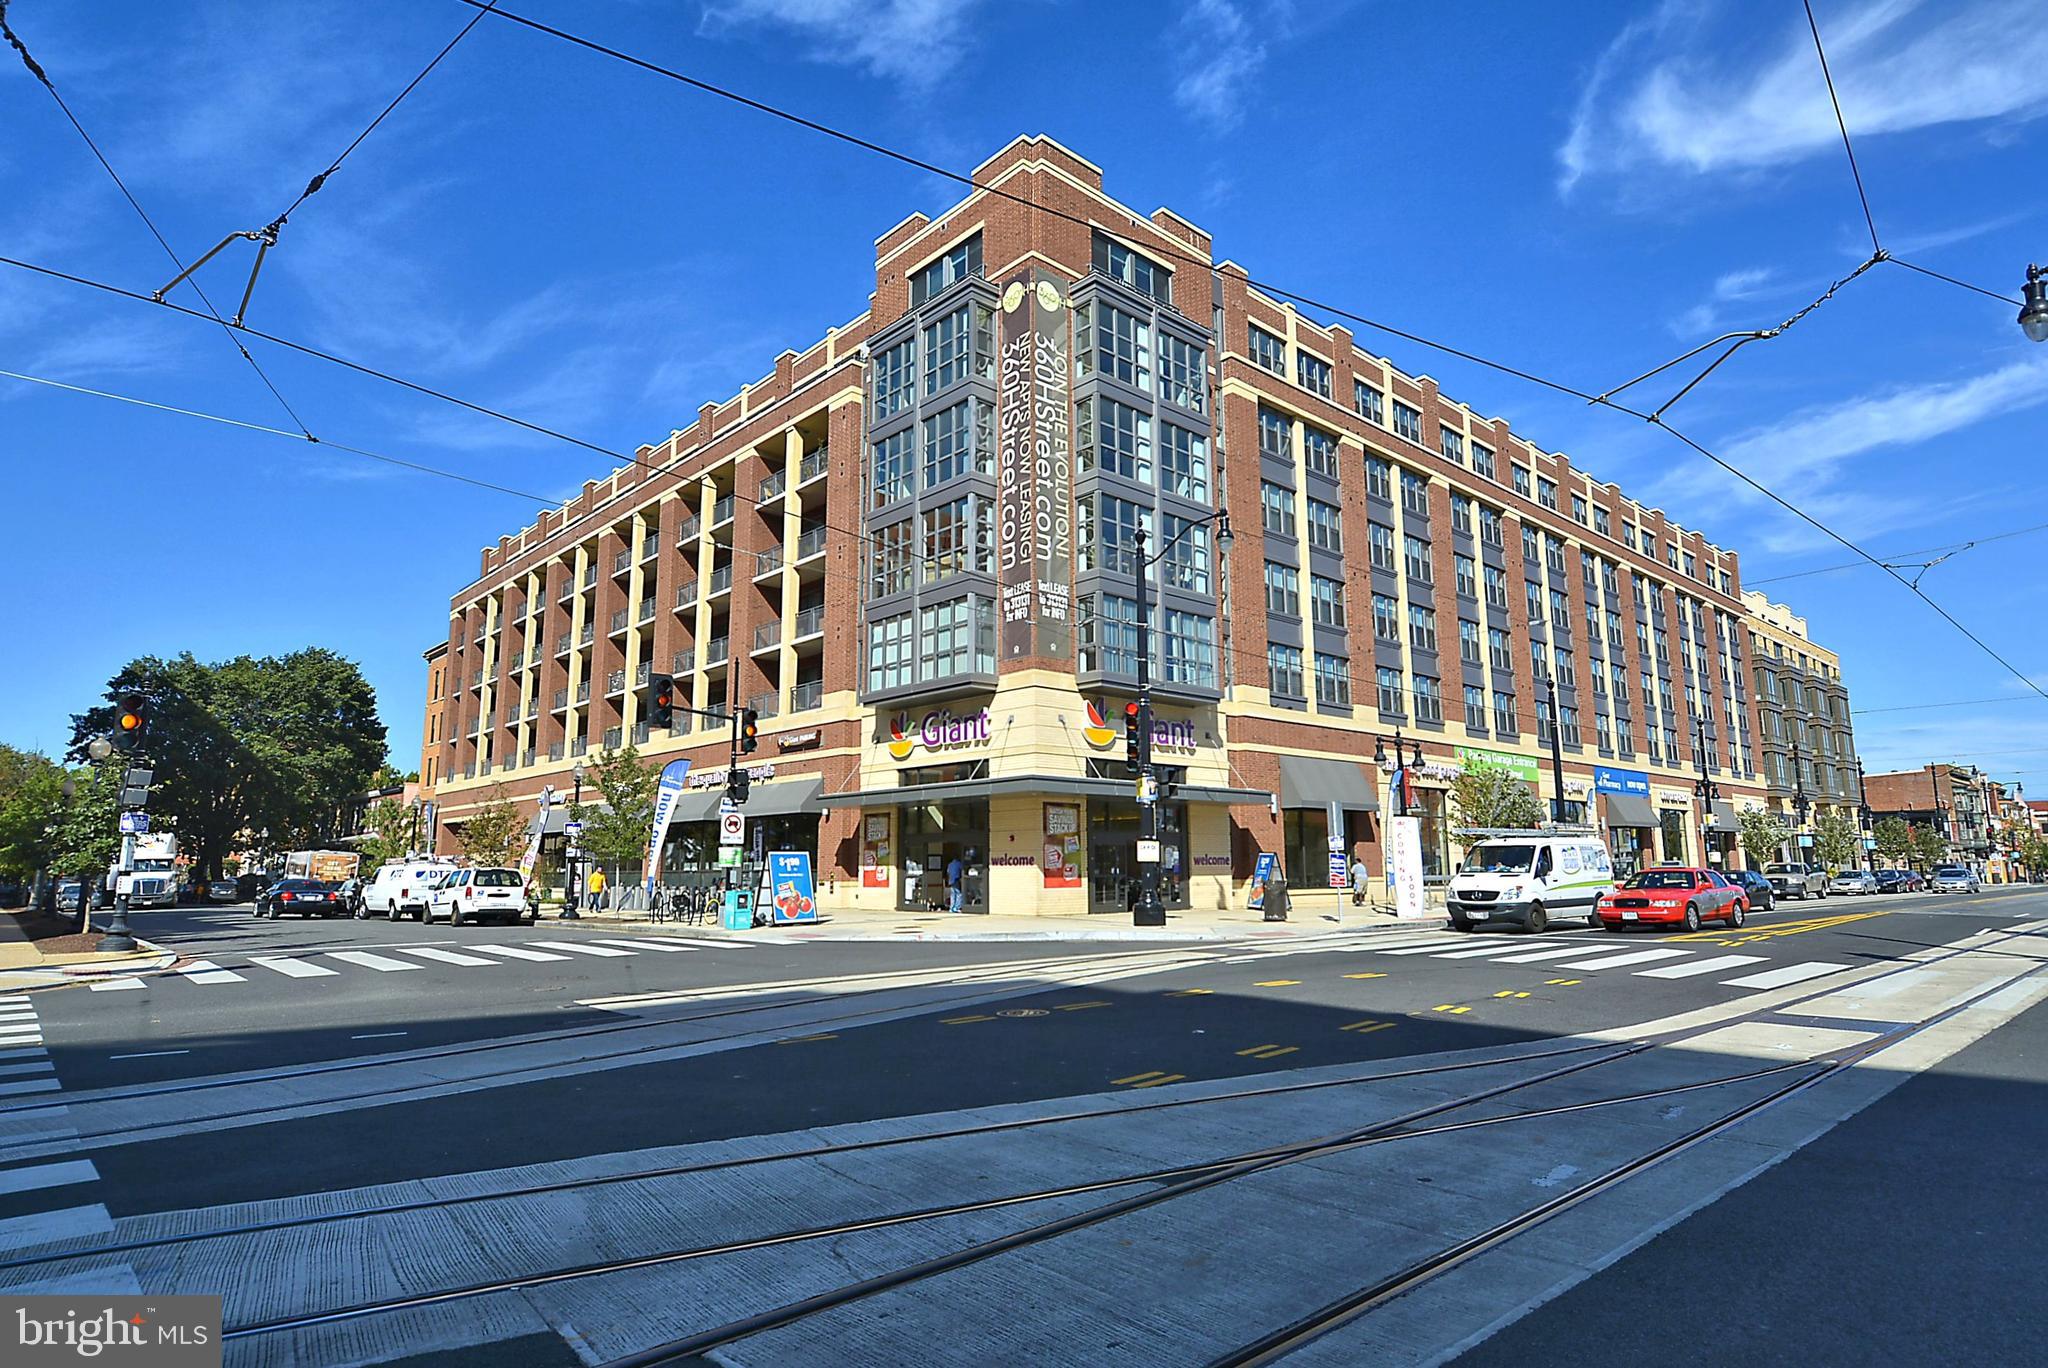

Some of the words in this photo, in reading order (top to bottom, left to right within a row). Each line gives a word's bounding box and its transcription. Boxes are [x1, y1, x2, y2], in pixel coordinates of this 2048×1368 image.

[1019, 330, 1031, 372] NEW
[1054, 345, 1068, 395] JOIN
[1019, 380, 1031, 423] APTS
[1054, 399, 1068, 435] THE
[1001, 338, 1020, 571] 360HStreet.com
[1019, 425, 1031, 475] NOW
[1034, 331, 1055, 562] 360HStreet.com
[1054, 438, 1069, 559] EVOLUTION!
[1019, 480, 1032, 565] LEASING!
[921, 706, 989, 746] Giant
[655, 792, 673, 825] now
[991, 853, 1035, 866] welcome
[1193, 854, 1230, 866] welcome
[1397, 832, 1406, 882] COMING
